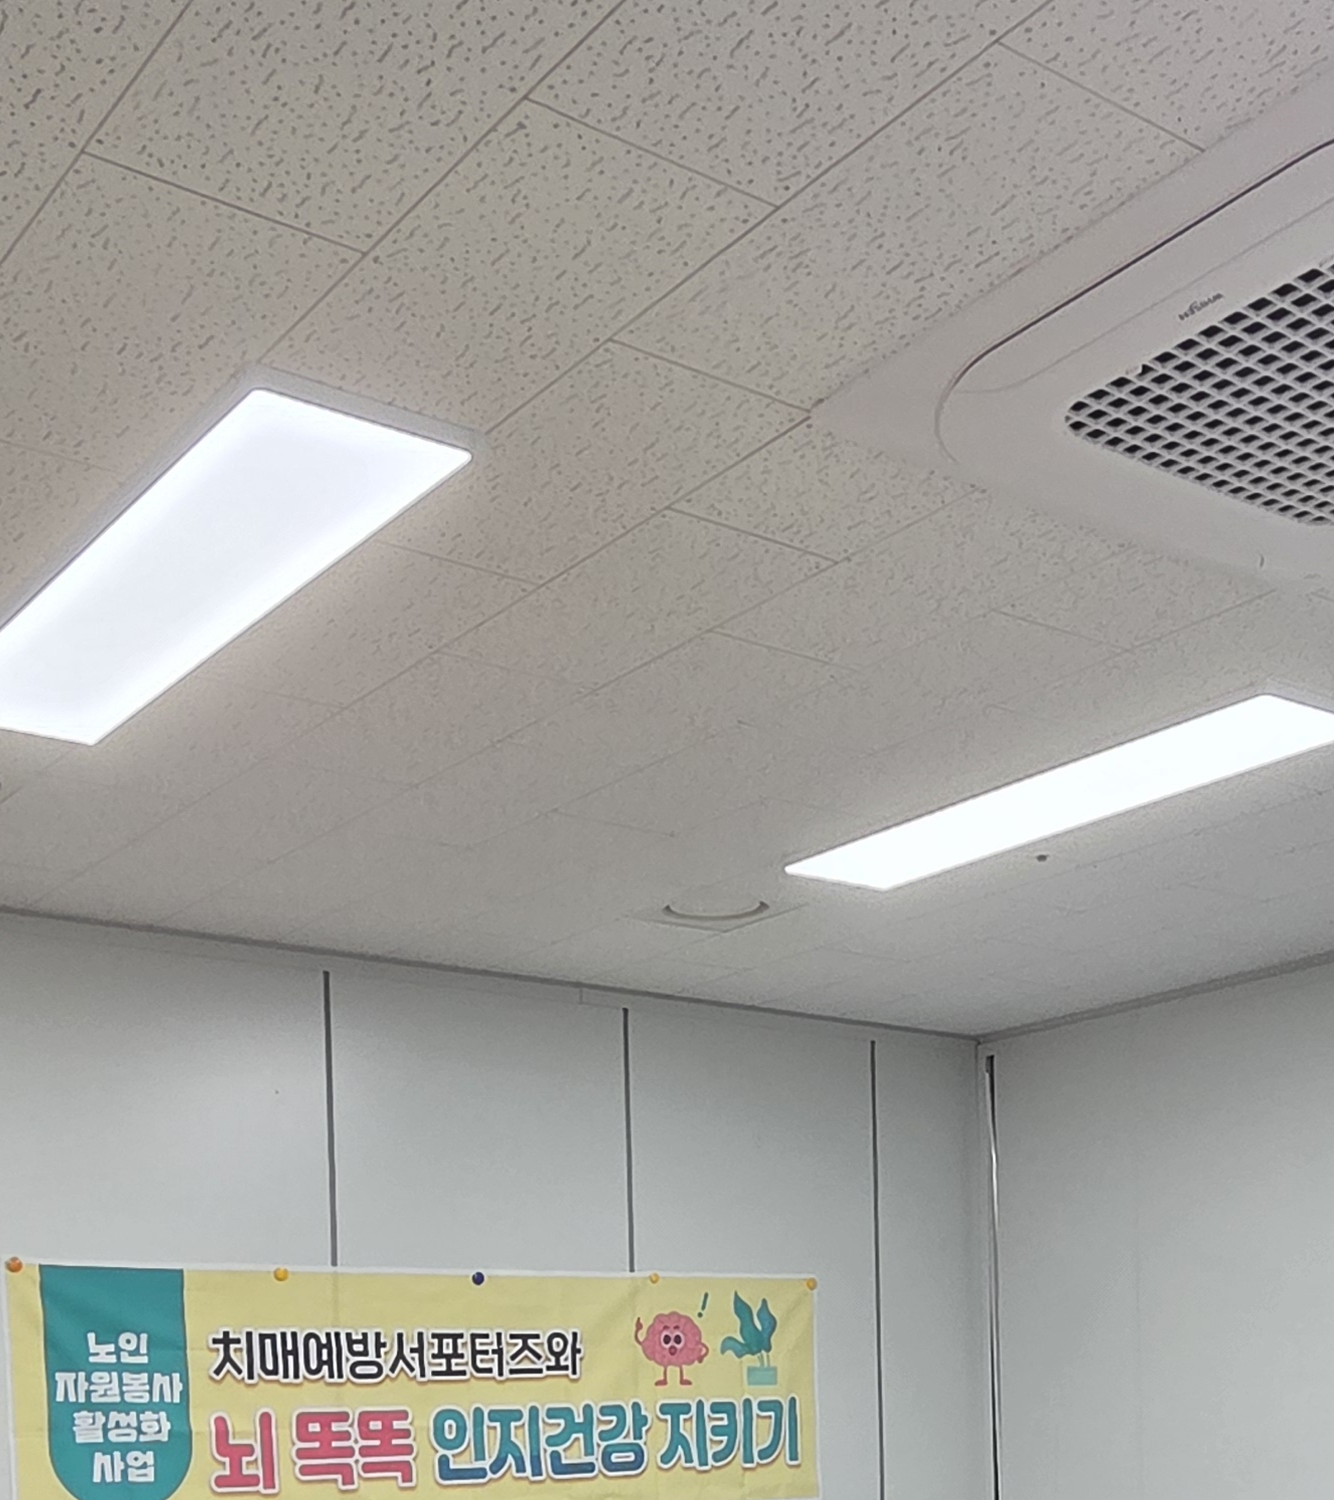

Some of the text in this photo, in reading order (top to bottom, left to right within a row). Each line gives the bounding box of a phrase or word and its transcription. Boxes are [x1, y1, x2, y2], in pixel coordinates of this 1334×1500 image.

[87, 1332, 149, 1364] 노인
[211, 1330, 582, 1380] 치매예방서포터즈와
[55, 1371, 183, 1403] 자원봉사
[72, 1410, 171, 1444] 활성화
[213, 1396, 800, 1490] 뇌 똑똑 인지건강 지키기
[92, 1450, 155, 1482] 사업
